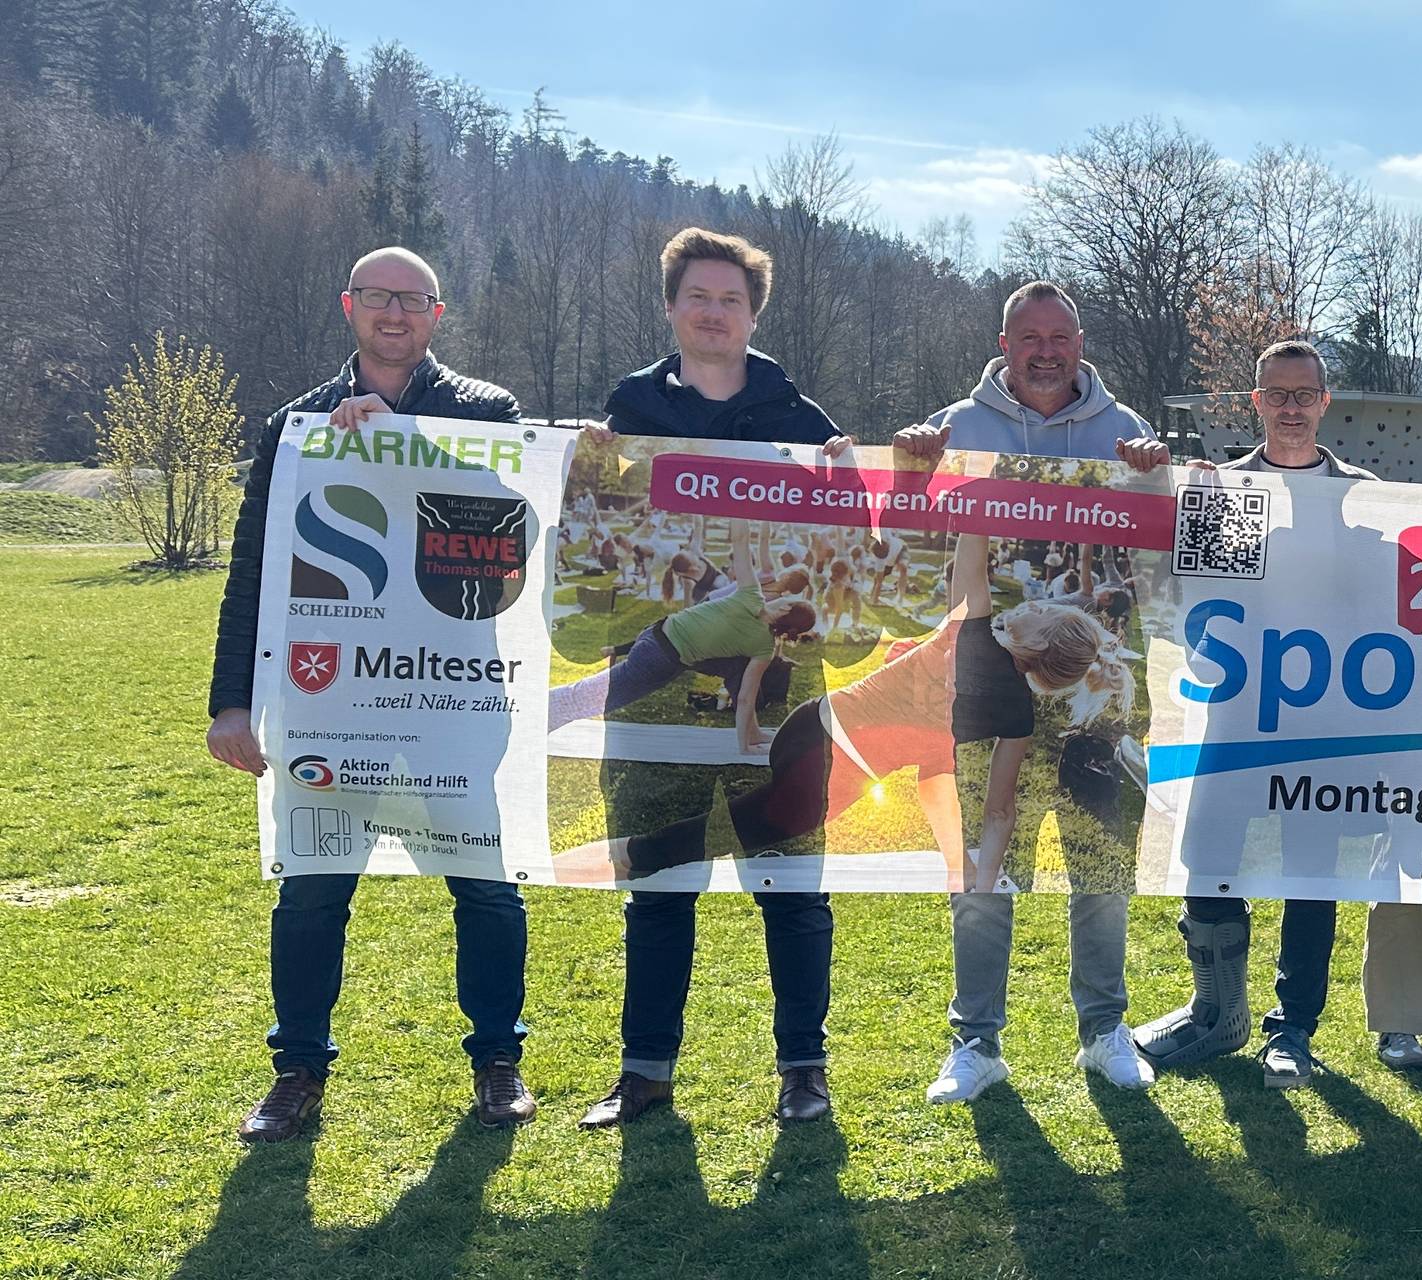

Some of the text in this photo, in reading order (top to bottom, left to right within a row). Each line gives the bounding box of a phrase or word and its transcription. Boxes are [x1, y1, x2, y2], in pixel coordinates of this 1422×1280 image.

[301, 426, 525, 474] BARMER
[674, 471, 1138, 530] QR Code scannen für mehr Infos.
[424, 532, 519, 562] REWE
[424, 561, 519, 579] Thomas Okon
[289, 603, 386, 619] SCHLEIDEN
[354, 646, 521, 683] Malteser
[418, 694, 466, 712] Nähe
[471, 696, 521, 713] zählt.
[288, 730, 421, 742] Bündnisorganisation von:
[340, 759, 389, 771] Aktion
[340, 774, 468, 788] Deutschland Hilft
[364, 820, 411, 837] Knappe
[461, 832, 500, 847] GmbH
